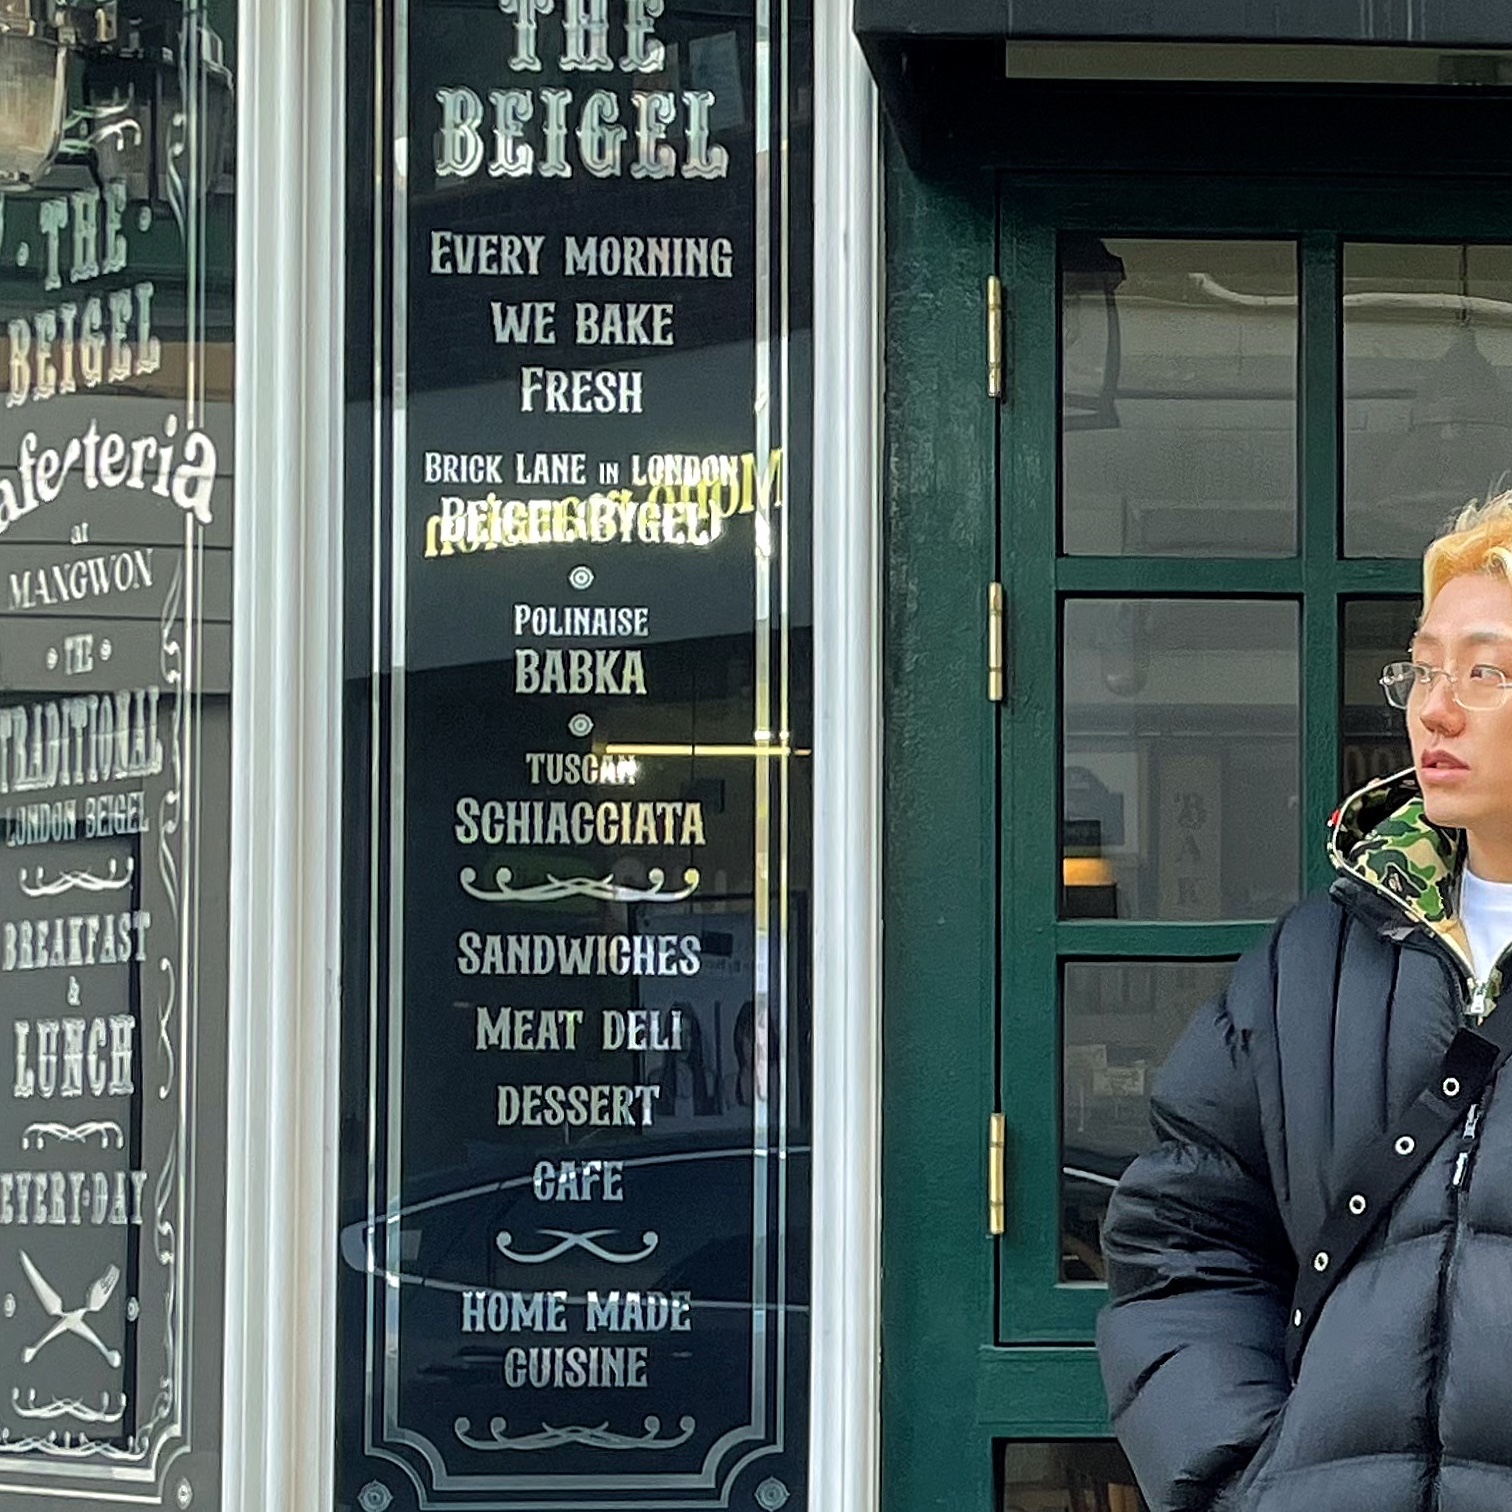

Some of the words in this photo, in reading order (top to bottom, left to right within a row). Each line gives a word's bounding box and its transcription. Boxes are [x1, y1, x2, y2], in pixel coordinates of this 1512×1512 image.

[501, 0, 665, 73] THE
[435, 86, 729, 179] BEIGEL
[40, 178, 127, 291] THE
[431, 230, 545, 275] EVERY
[565, 235, 733, 278] MORNING
[7, 282, 160, 408] BEIGEL
[491, 301, 556, 344] WE
[576, 302, 674, 345] BAKE
[521, 366, 643, 413] FRESH
[424, 452, 503, 483] BRICK
[516, 453, 587, 484] LANE
[600, 462, 619, 484] IN
[632, 454, 740, 486] LONDON
[70, 522, 89, 545] at
[9, 548, 154, 610] MANGWON
[514, 604, 649, 636] POLINAISE
[515, 648, 647, 694] BABKA
[526, 753, 636, 785] TUSCAN
[6, 799, 77, 847] LONDON
[85, 791, 149, 838] BEIGEL
[455, 797, 706, 845] SCHIACCIATA
[3, 911, 151, 970] BREAKFAST
[458, 931, 701, 976] SANDWICHES
[476, 1007, 583, 1050] MEAT
[603, 1010, 682, 1051] DELI
[14, 1014, 135, 1098] LUNCH
[497, 1085, 660, 1126] DESSERT
[533, 1161, 623, 1200] CAFE
[462, 1290, 567, 1331] HOME
[586, 1290, 692, 1331] MADE
[505, 1347, 648, 1388] CUISINE
